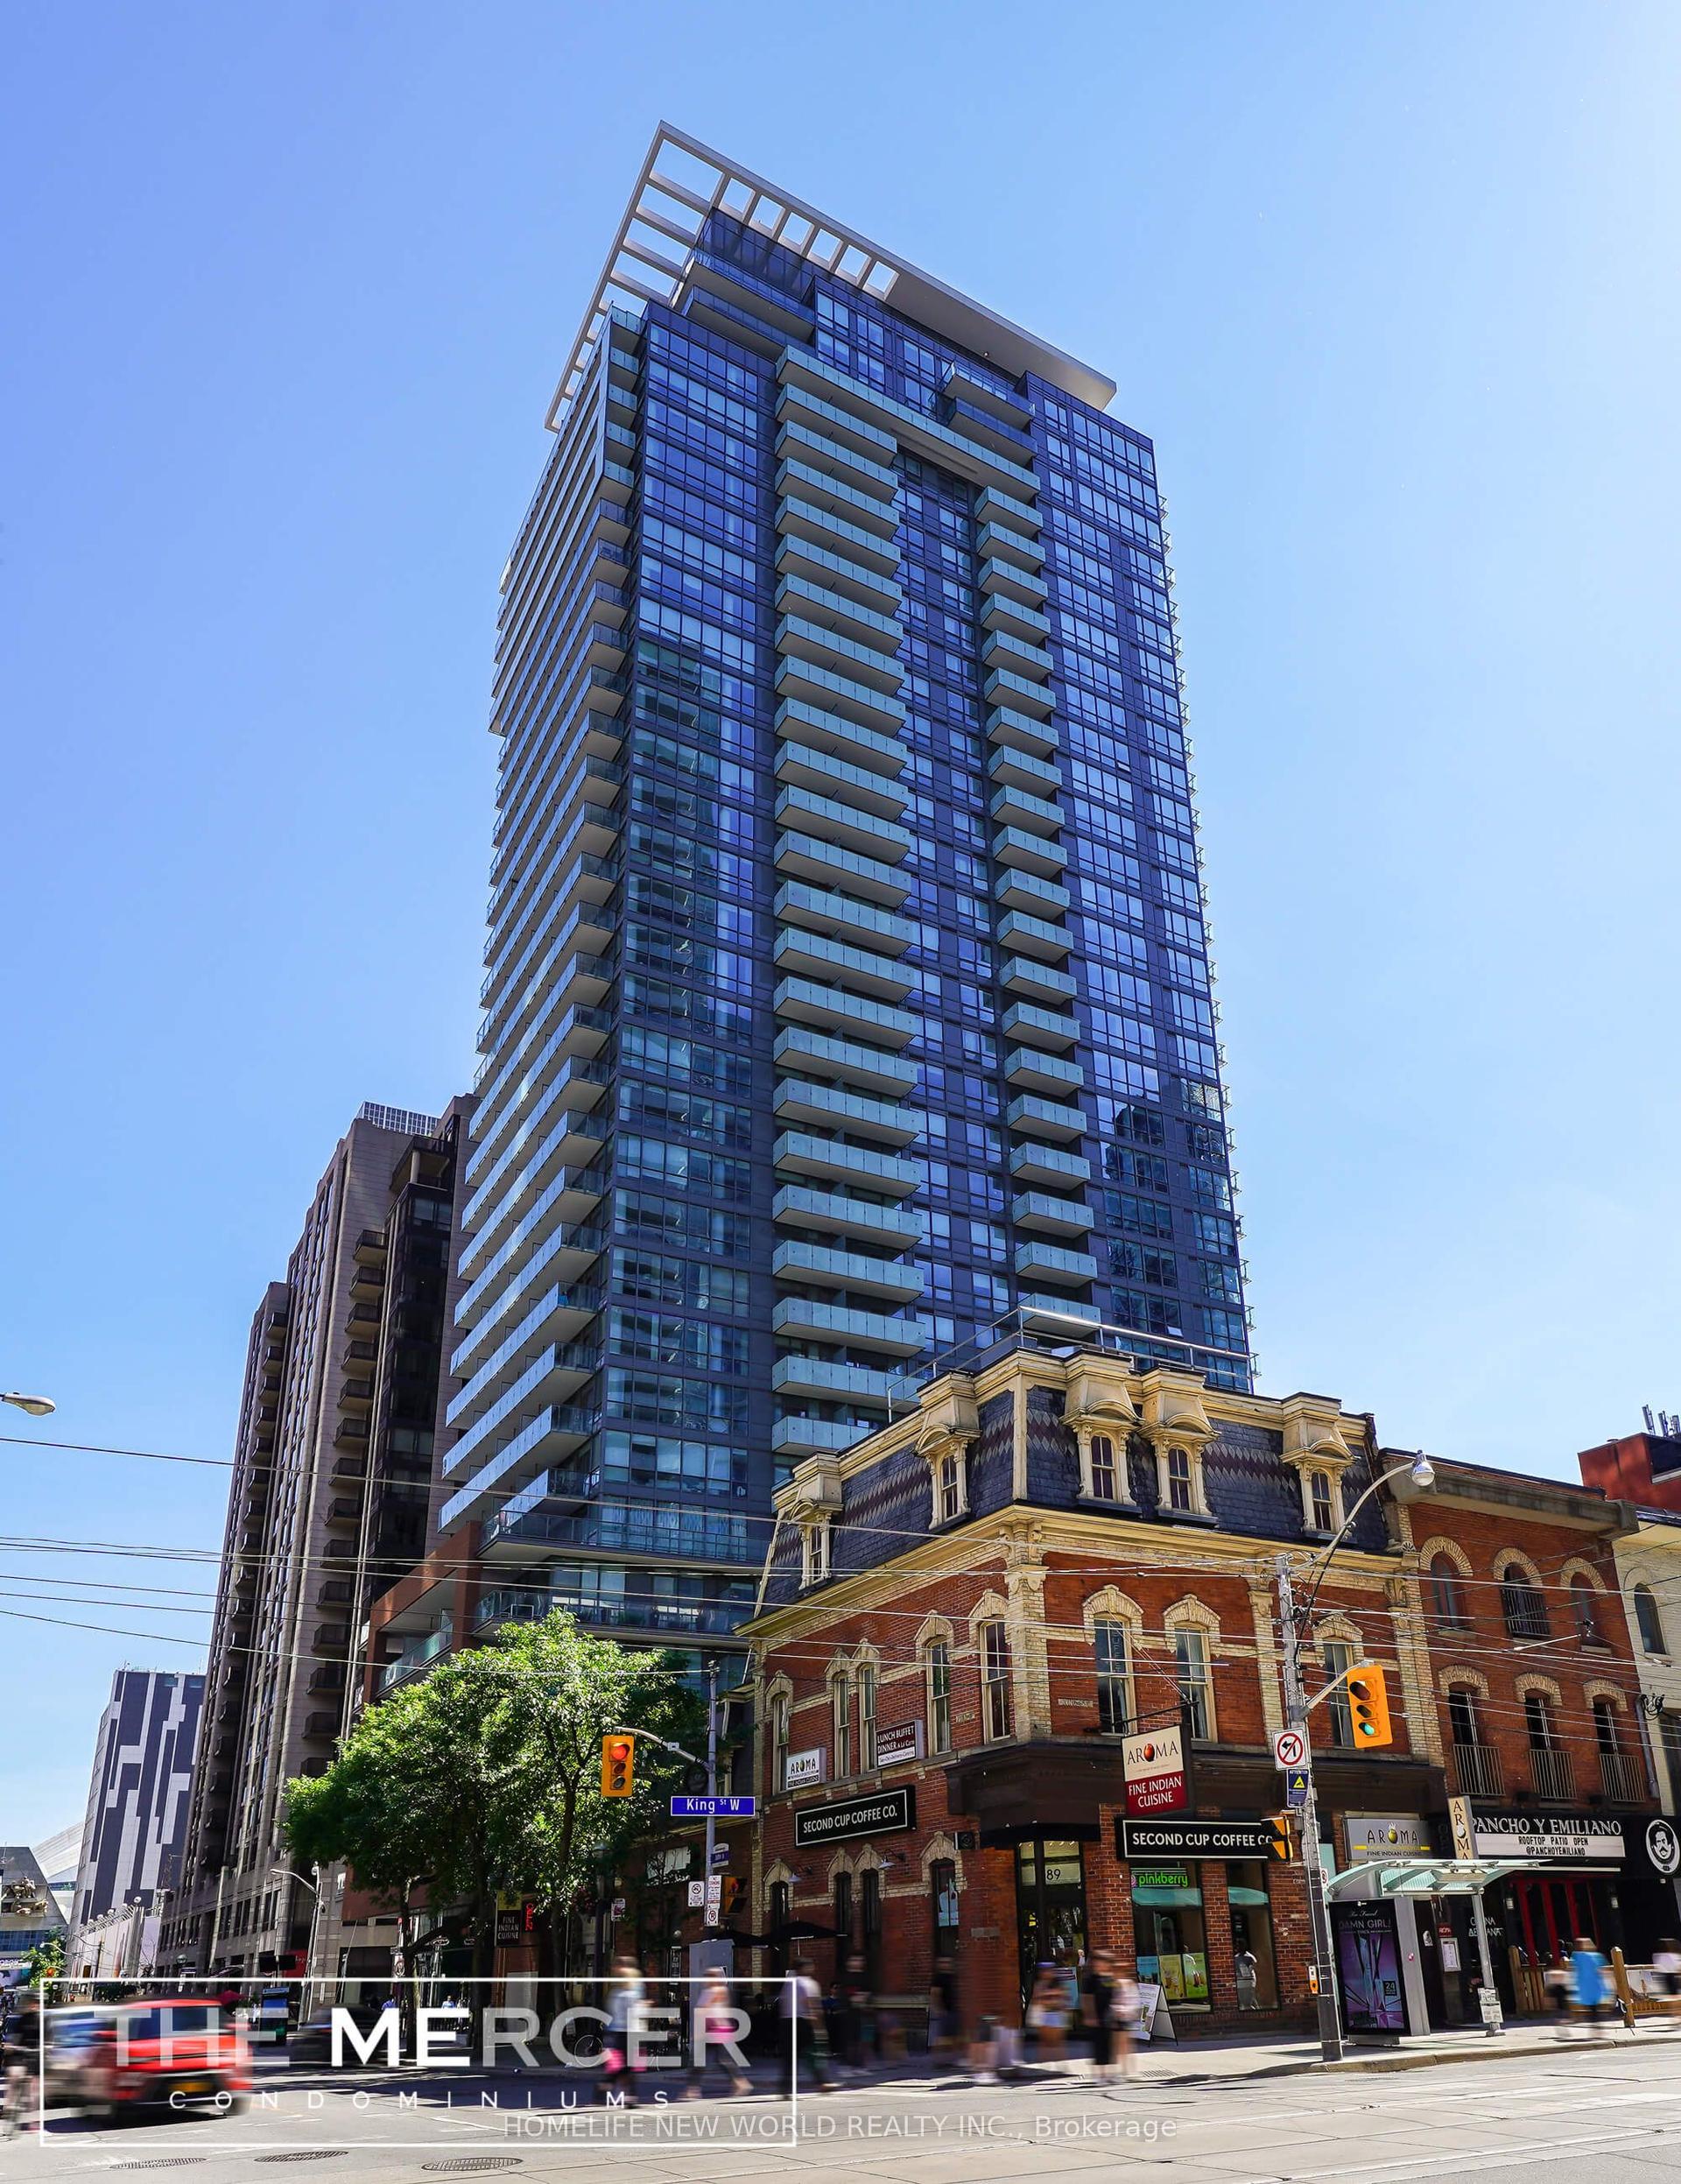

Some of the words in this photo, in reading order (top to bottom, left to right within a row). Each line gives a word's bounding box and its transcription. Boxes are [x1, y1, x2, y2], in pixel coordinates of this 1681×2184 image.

[877, 1730, 896, 1744] LUNCH
[896, 1725, 914, 1738] BUFFET
[877, 1741, 897, 1754] DINNER
[1128, 1740, 1179, 1765] AROMA
[791, 1758, 816, 1775] AROMA
[1129, 1783, 1147, 1796] FINE
[1149, 1775, 1182, 1793] INDIAN
[686, 1798, 715, 1814] King
[730, 1799, 740, 1811] W
[1137, 1791, 1174, 1808] CUISINE
[803, 1817, 833, 1834] SECOND
[834, 1814, 850, 1828] CUP
[852, 1807, 882, 1823] COFFEE
[883, 1804, 897, 1818] CO.
[1533, 1818, 1546, 1835] Y
[1551, 1819, 1622, 1835] EMILIANO
[1132, 1832, 1183, 1846] SECOND
[1185, 1834, 1209, 1847] CUP
[1213, 1834, 1256, 1847] COFFEE
[1367, 1828, 1420, 1844] AROMA
[1518, 1835, 1546, 1845] ROOFTOP
[1550, 1836, 1568, 1845] PATIO
[1573, 1837, 1589, 1846] OPEN
[1526, 1846, 1586, 1856] @PANCHOYEMILIANO
[1046, 1868, 1061, 1881] 89
[1138, 1871, 1189, 1888] pinkberry
